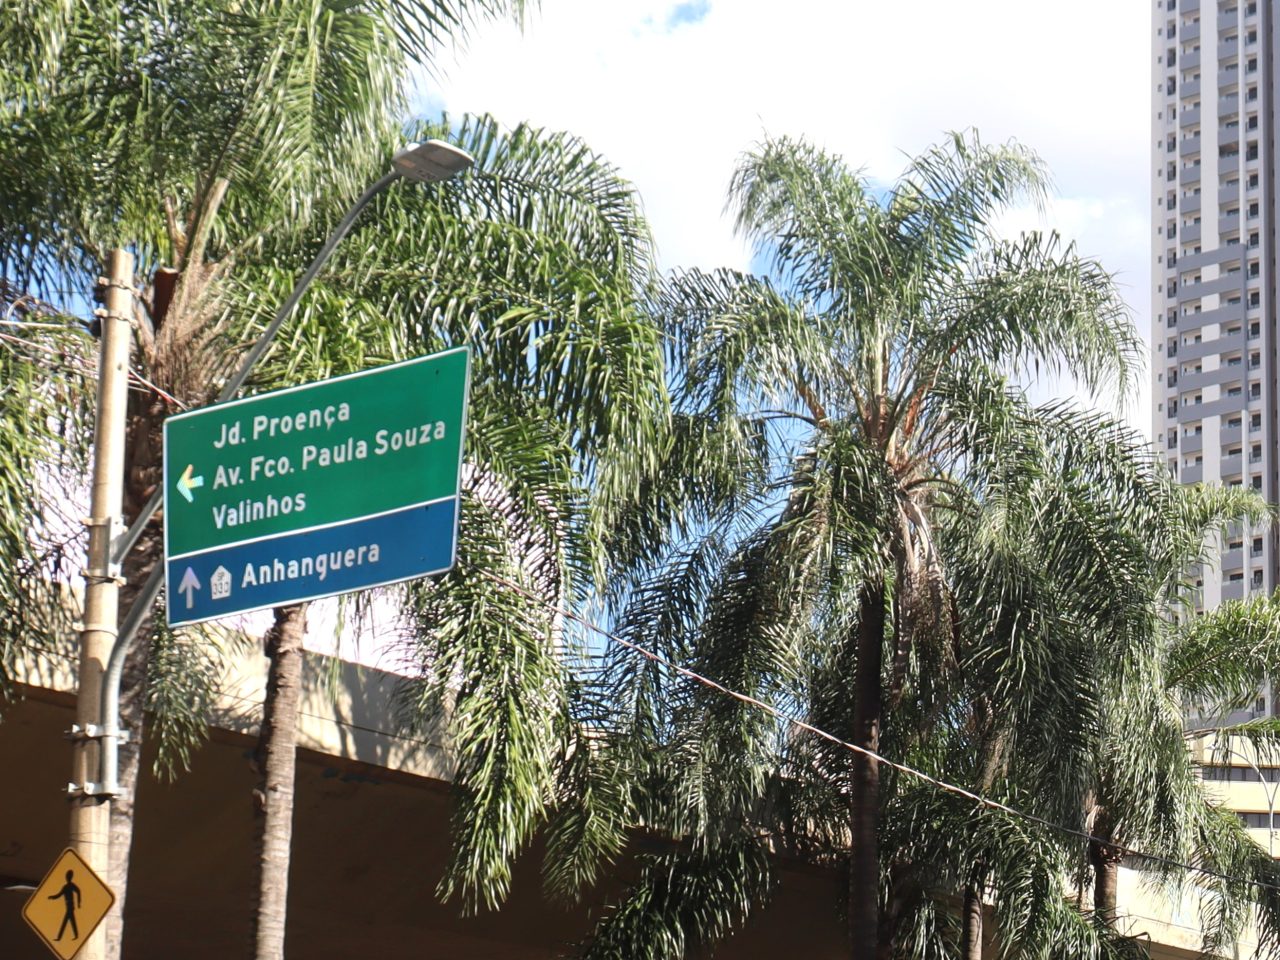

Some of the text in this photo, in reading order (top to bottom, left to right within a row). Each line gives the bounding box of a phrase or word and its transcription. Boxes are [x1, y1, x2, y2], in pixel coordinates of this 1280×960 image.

[213, 402, 351, 449] Jd. Proença
[212, 420, 446, 490] Av. Fco. Paula Souza
[212, 493, 307, 529] Valinhos
[241, 543, 380, 589] Anhanguera
